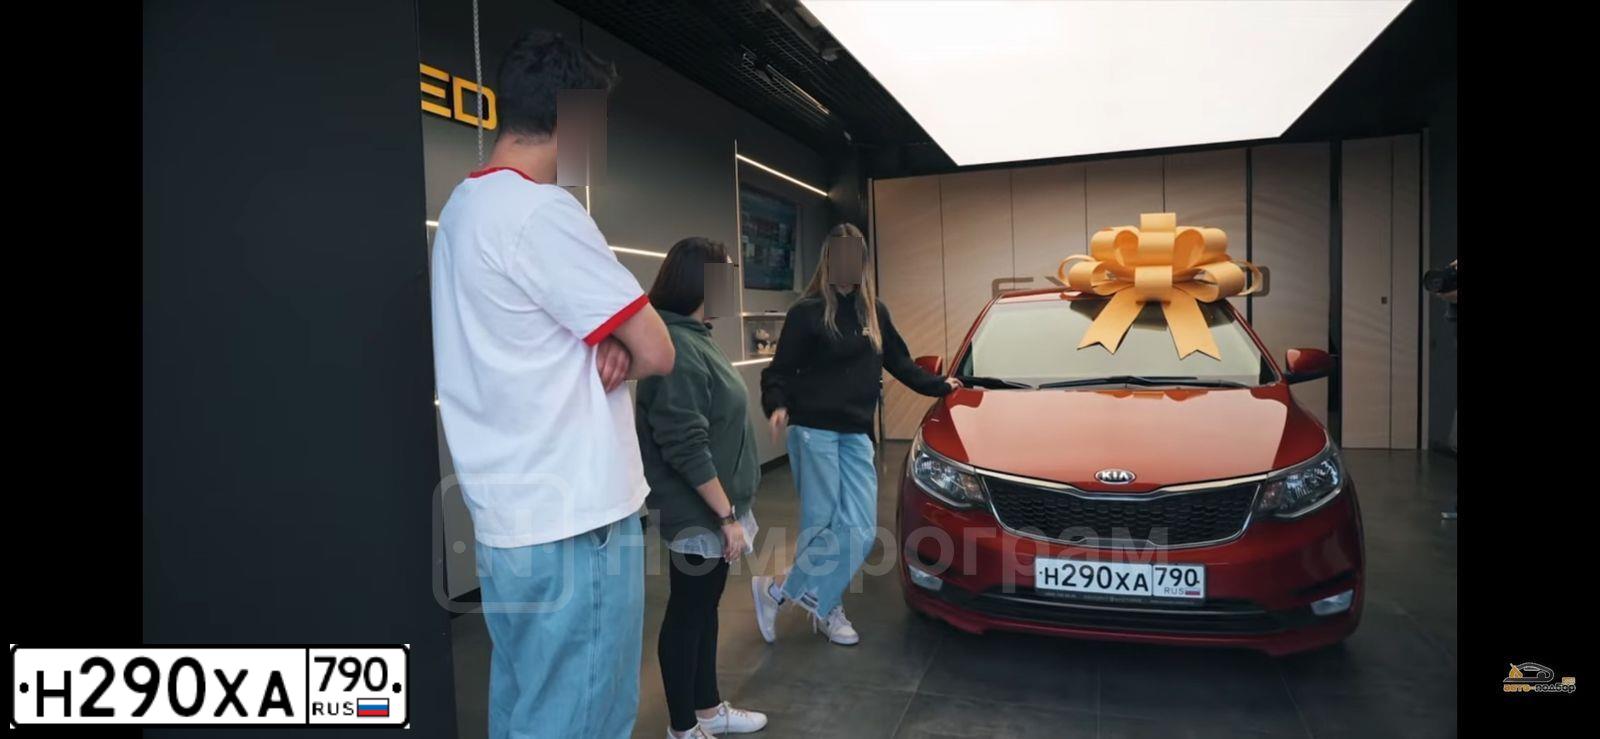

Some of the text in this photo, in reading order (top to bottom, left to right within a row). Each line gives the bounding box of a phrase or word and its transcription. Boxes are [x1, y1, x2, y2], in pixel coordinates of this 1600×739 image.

[1101, 471, 1130, 481] KIA
[1154, 567, 1199, 587] 790
[1163, 587, 1185, 596] RUS
